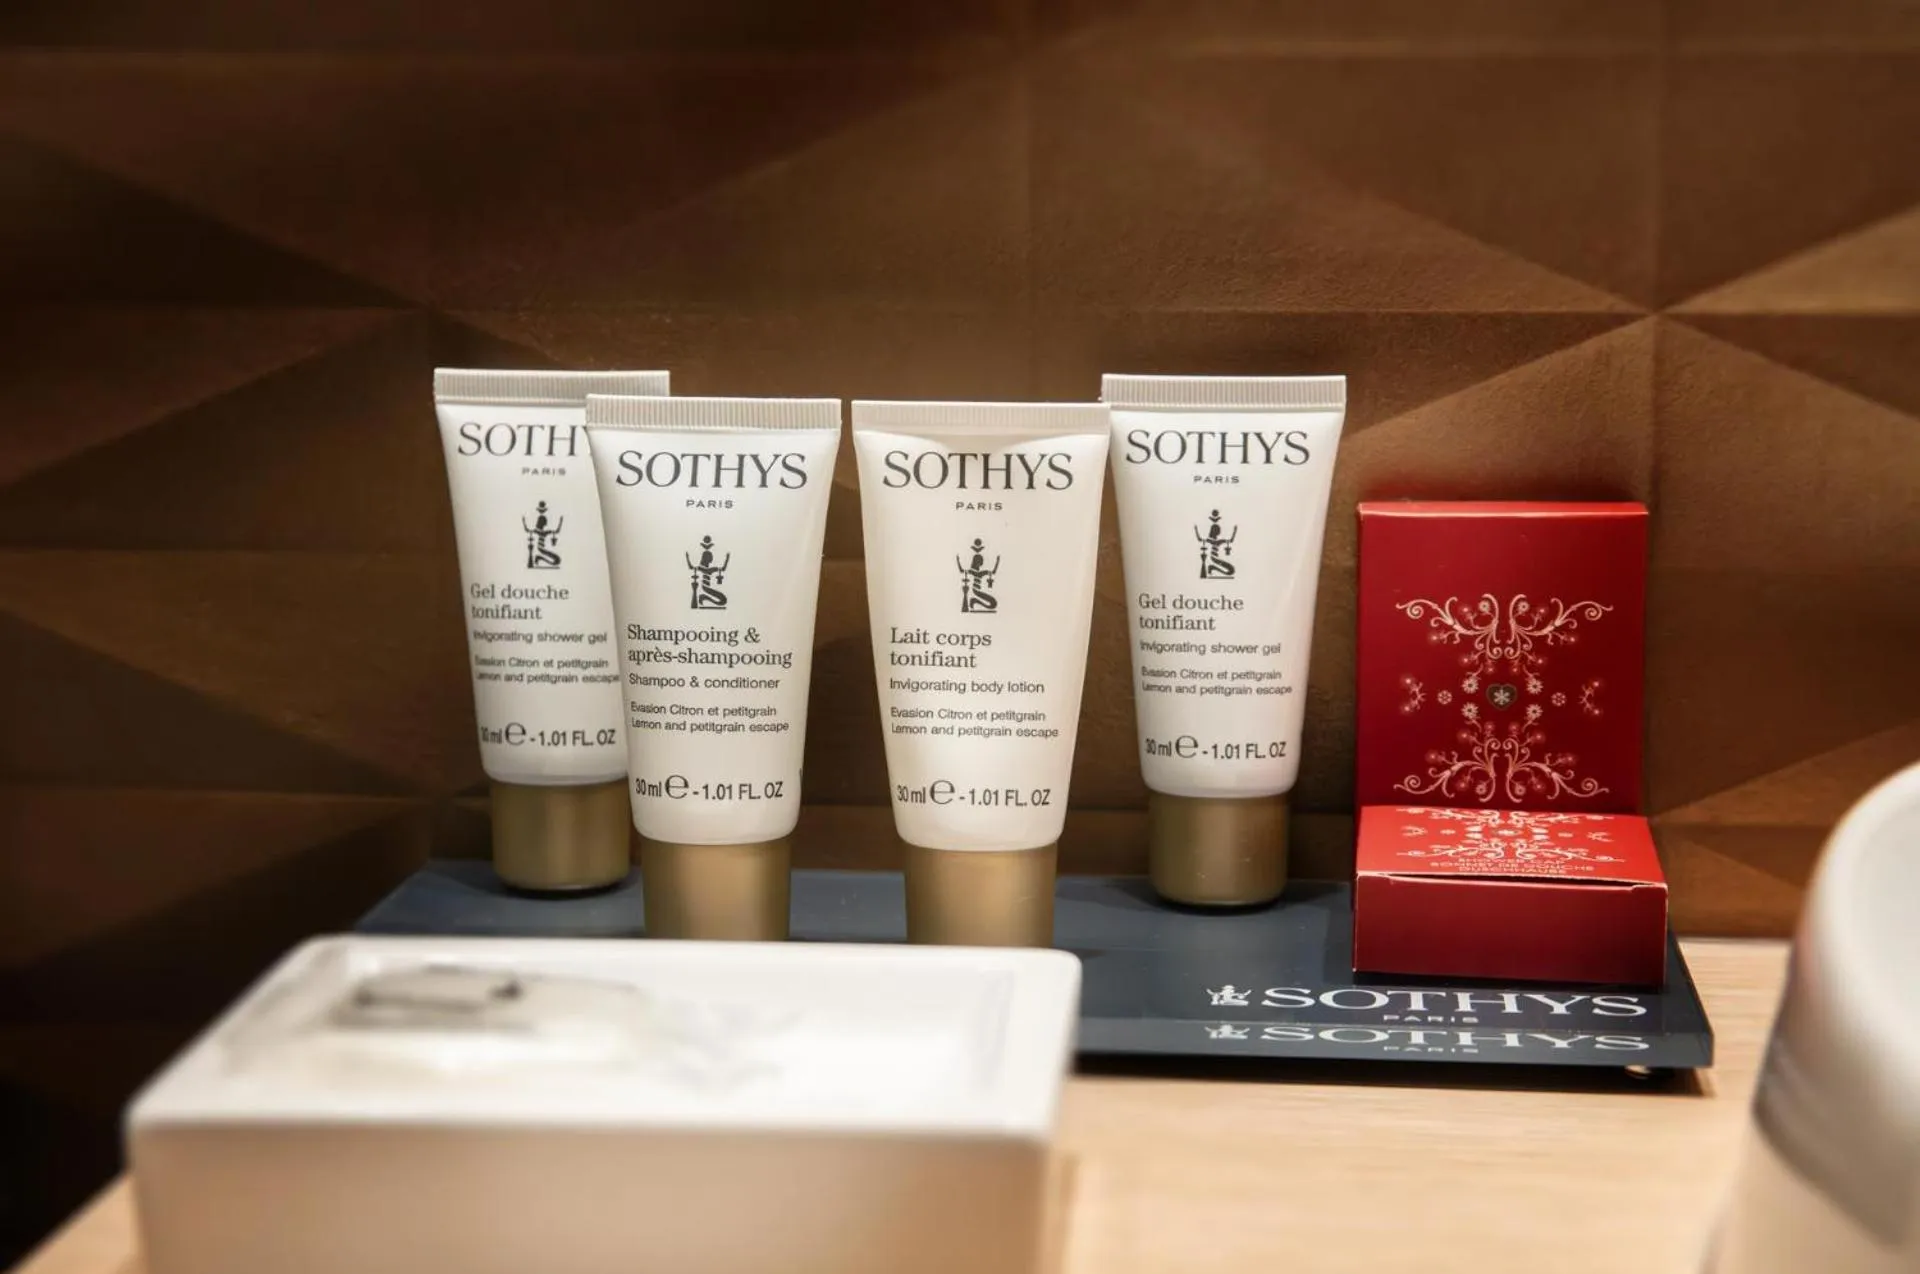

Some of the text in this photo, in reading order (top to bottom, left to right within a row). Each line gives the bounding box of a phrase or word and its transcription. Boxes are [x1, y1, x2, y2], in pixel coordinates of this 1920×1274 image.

[458, 422, 587, 456] SOTH
[1126, 429, 1310, 465] SOTHYS
[521, 467, 566, 476] PARIS
[616, 450, 807, 489] SOTHYS
[883, 450, 1073, 490] SOTHYS
[1193, 475, 1240, 484] PARIS
[686, 500, 734, 509] PARIS
[956, 502, 1003, 510] PARIS
[471, 583, 569, 600] Gel douche
[1138, 593, 1244, 611] Gel douche
[471, 604, 542, 620] tonifiant
[1139, 615, 1216, 631] tonifiant
[537, 630, 585, 643] shower
[588, 631, 607, 644] gel
[627, 624, 761, 647] Shampooing &
[890, 627, 992, 649] Lait corps
[1140, 640, 1281, 655] Invigorating shower gel
[508, 656, 539, 668] Citron
[543, 658, 553, 667] et
[557, 657, 609, 669] petitgrain
[628, 647, 792, 668] après-shampooing
[890, 651, 977, 668] tonifiant
[504, 672, 523, 682] and
[629, 672, 780, 689] Shampoo & conditioner
[1180, 668, 1213, 680] Citron
[1217, 670, 1228, 680] et
[1231, 669, 1282, 681] petitgrain
[890, 678, 1045, 694] Invigorating body lotion
[1175, 683, 1195, 694] and
[1200, 684, 1252, 696] petitgrain
[1256, 686, 1292, 695] escape
[631, 702, 776, 718] Evasion Citron et petitgrain
[890, 707, 1045, 723] Evasion Citron et petitgrain
[632, 719, 789, 734] Lemon and petitgrain escape
[891, 723, 1059, 738] Lemon and petitgrain escape
[539, 731, 567, 746] 1.01
[572, 731, 594, 746] FL.
[597, 729, 616, 745] OZ
[1211, 743, 1240, 759] 1.01
[1246, 744, 1265, 759] FL.
[1270, 742, 1286, 758] OZ
[702, 784, 733, 800] 1.01
[739, 783, 761, 800] FL.
[764, 781, 783, 799] OZ
[969, 788, 999, 806] 1.01
[1005, 789, 1027, 806] FL.
[1031, 788, 1050, 806] OZ
[1261, 986, 1647, 1017] SOTHYS
[1261, 1025, 1650, 1050] SOTHYS
